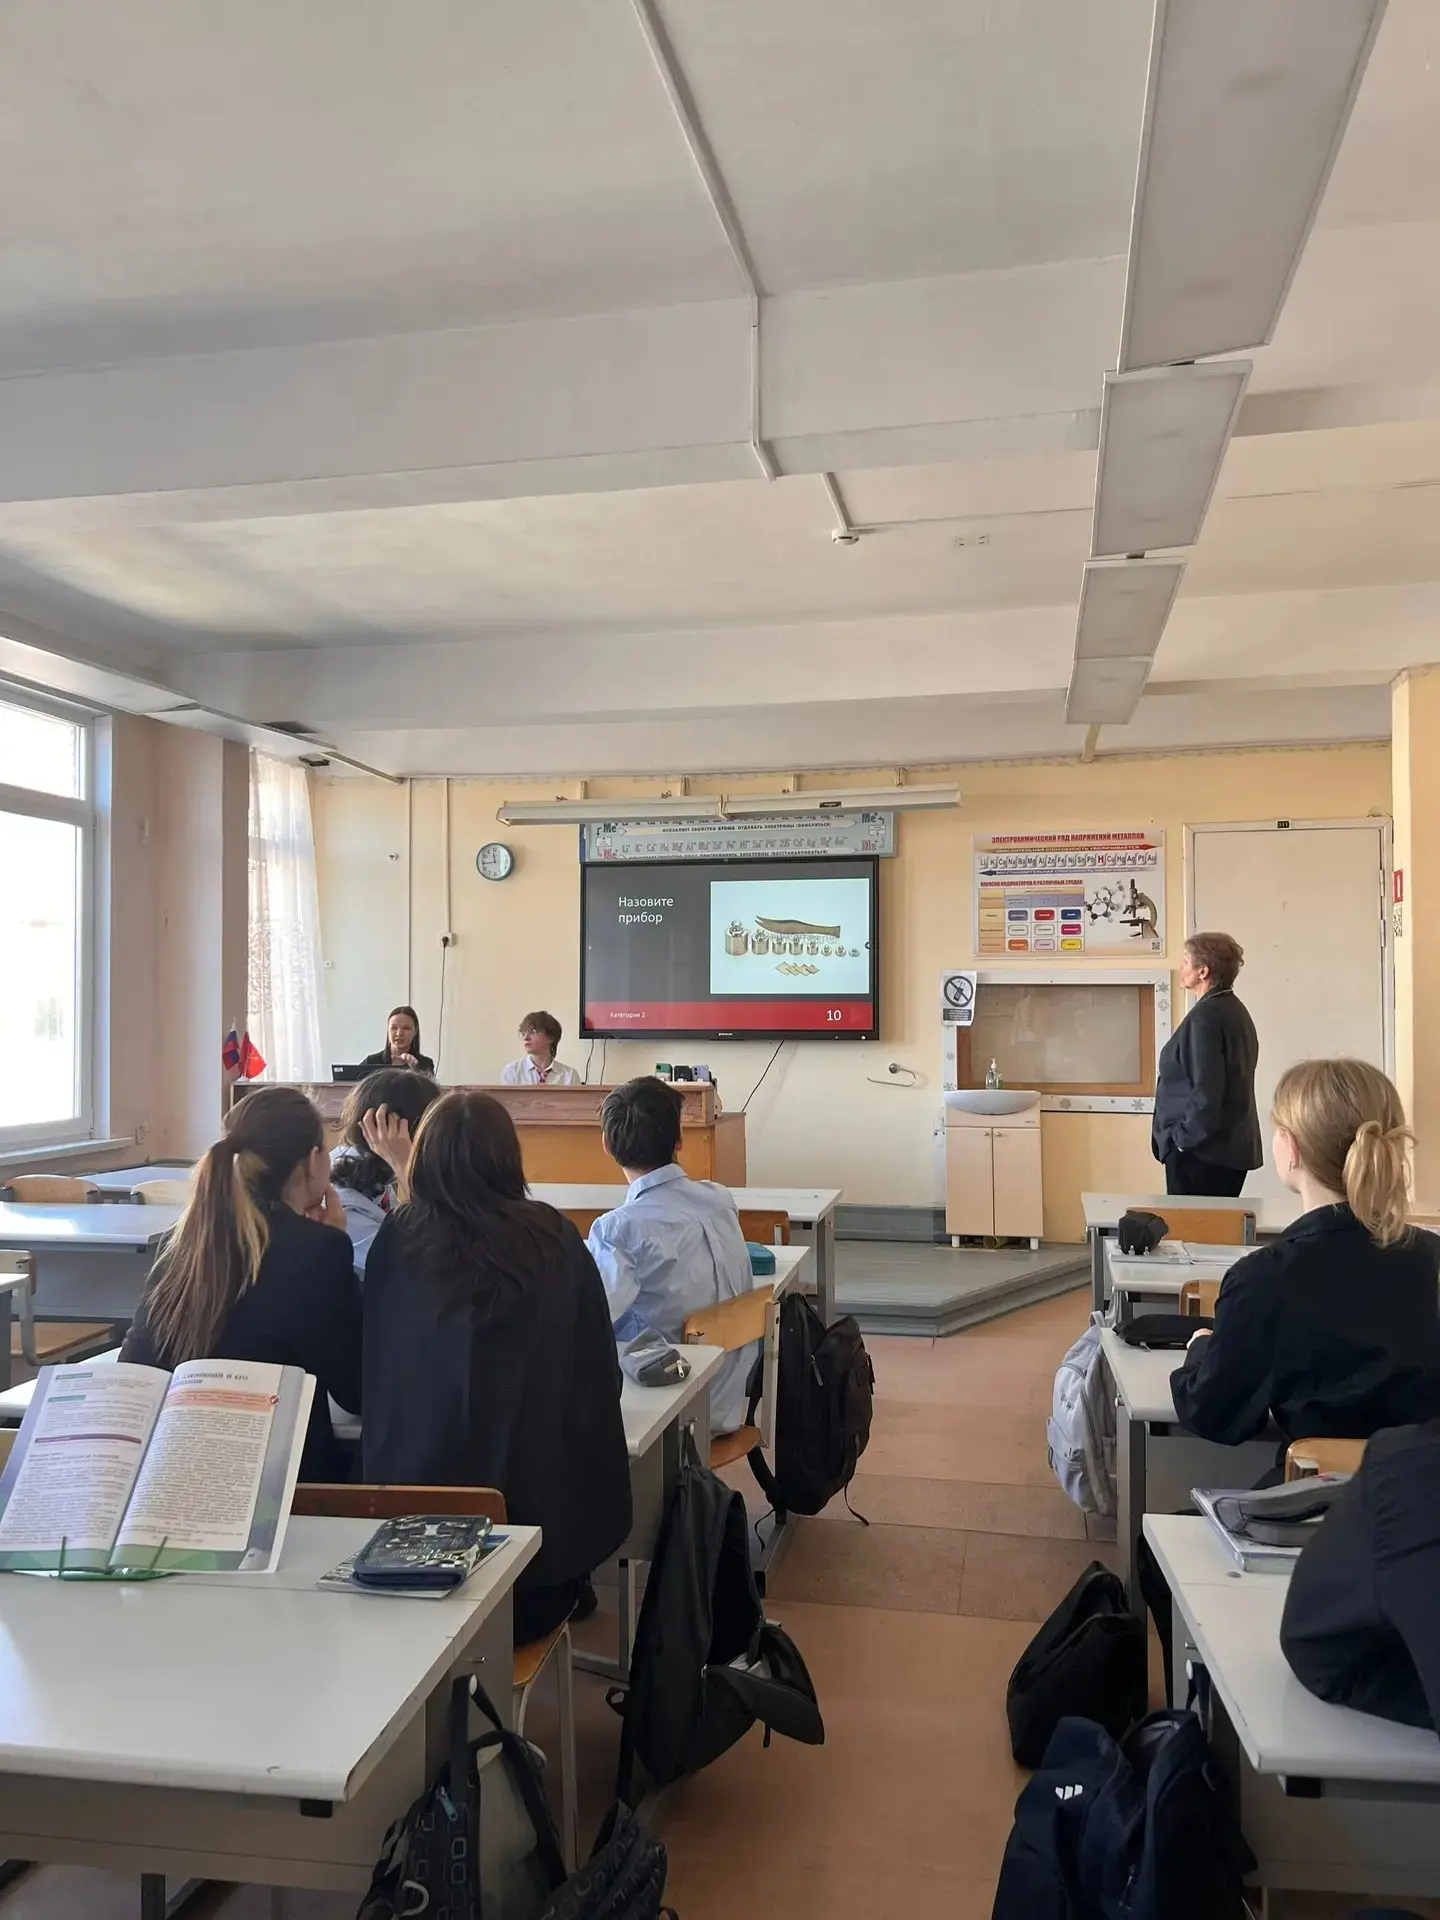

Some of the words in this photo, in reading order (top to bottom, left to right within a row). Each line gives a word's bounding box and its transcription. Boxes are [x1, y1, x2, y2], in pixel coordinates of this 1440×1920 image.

[991, 835, 1057, 844] ЭЛЕКТРОХИМИЧЕСКИЙ
[1057, 834, 1070, 842] РЯД
[1071, 833, 1111, 841] НАПРЯЖЕНИЙ
[1112, 832, 1145, 840] МЕТАЛЛОВ
[618, 896, 674, 907] Назовите
[618, 911, 663, 925] прибор
[826, 1009, 842, 1021] 10
